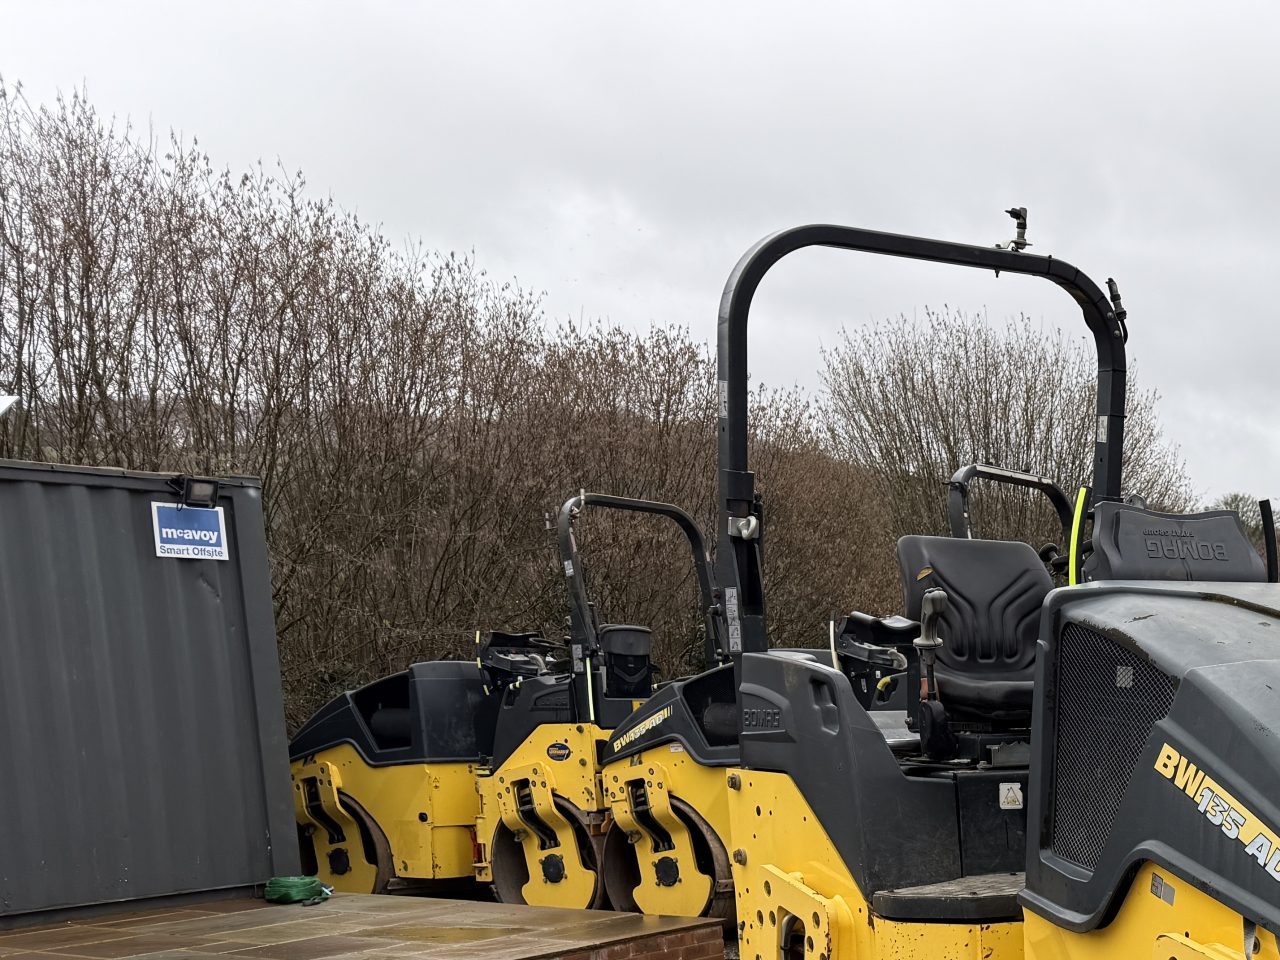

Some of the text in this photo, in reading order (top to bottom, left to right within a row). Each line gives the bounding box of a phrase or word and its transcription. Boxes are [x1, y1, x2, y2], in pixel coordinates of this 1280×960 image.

[159, 545, 223, 558] Smart Offsite
[1144, 539, 1230, 561] BOMAG
[743, 708, 781, 729] BOMAG
